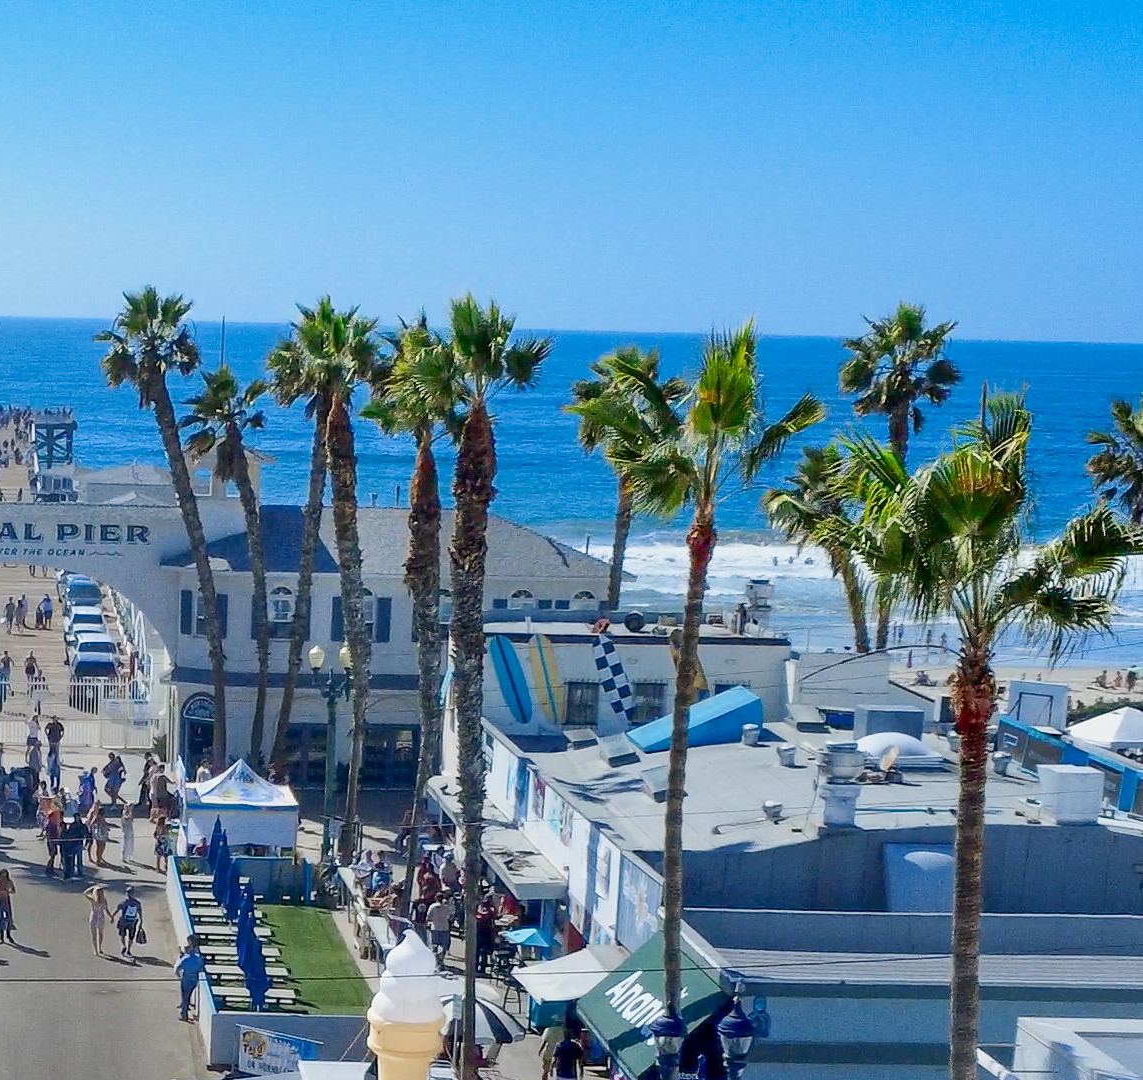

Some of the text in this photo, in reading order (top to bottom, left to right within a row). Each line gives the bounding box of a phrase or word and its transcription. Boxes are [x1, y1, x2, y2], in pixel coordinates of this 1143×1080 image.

[56, 524, 151, 545] PIER
[22, 548, 45, 556] THE
[47, 548, 86, 557] OCEAN
